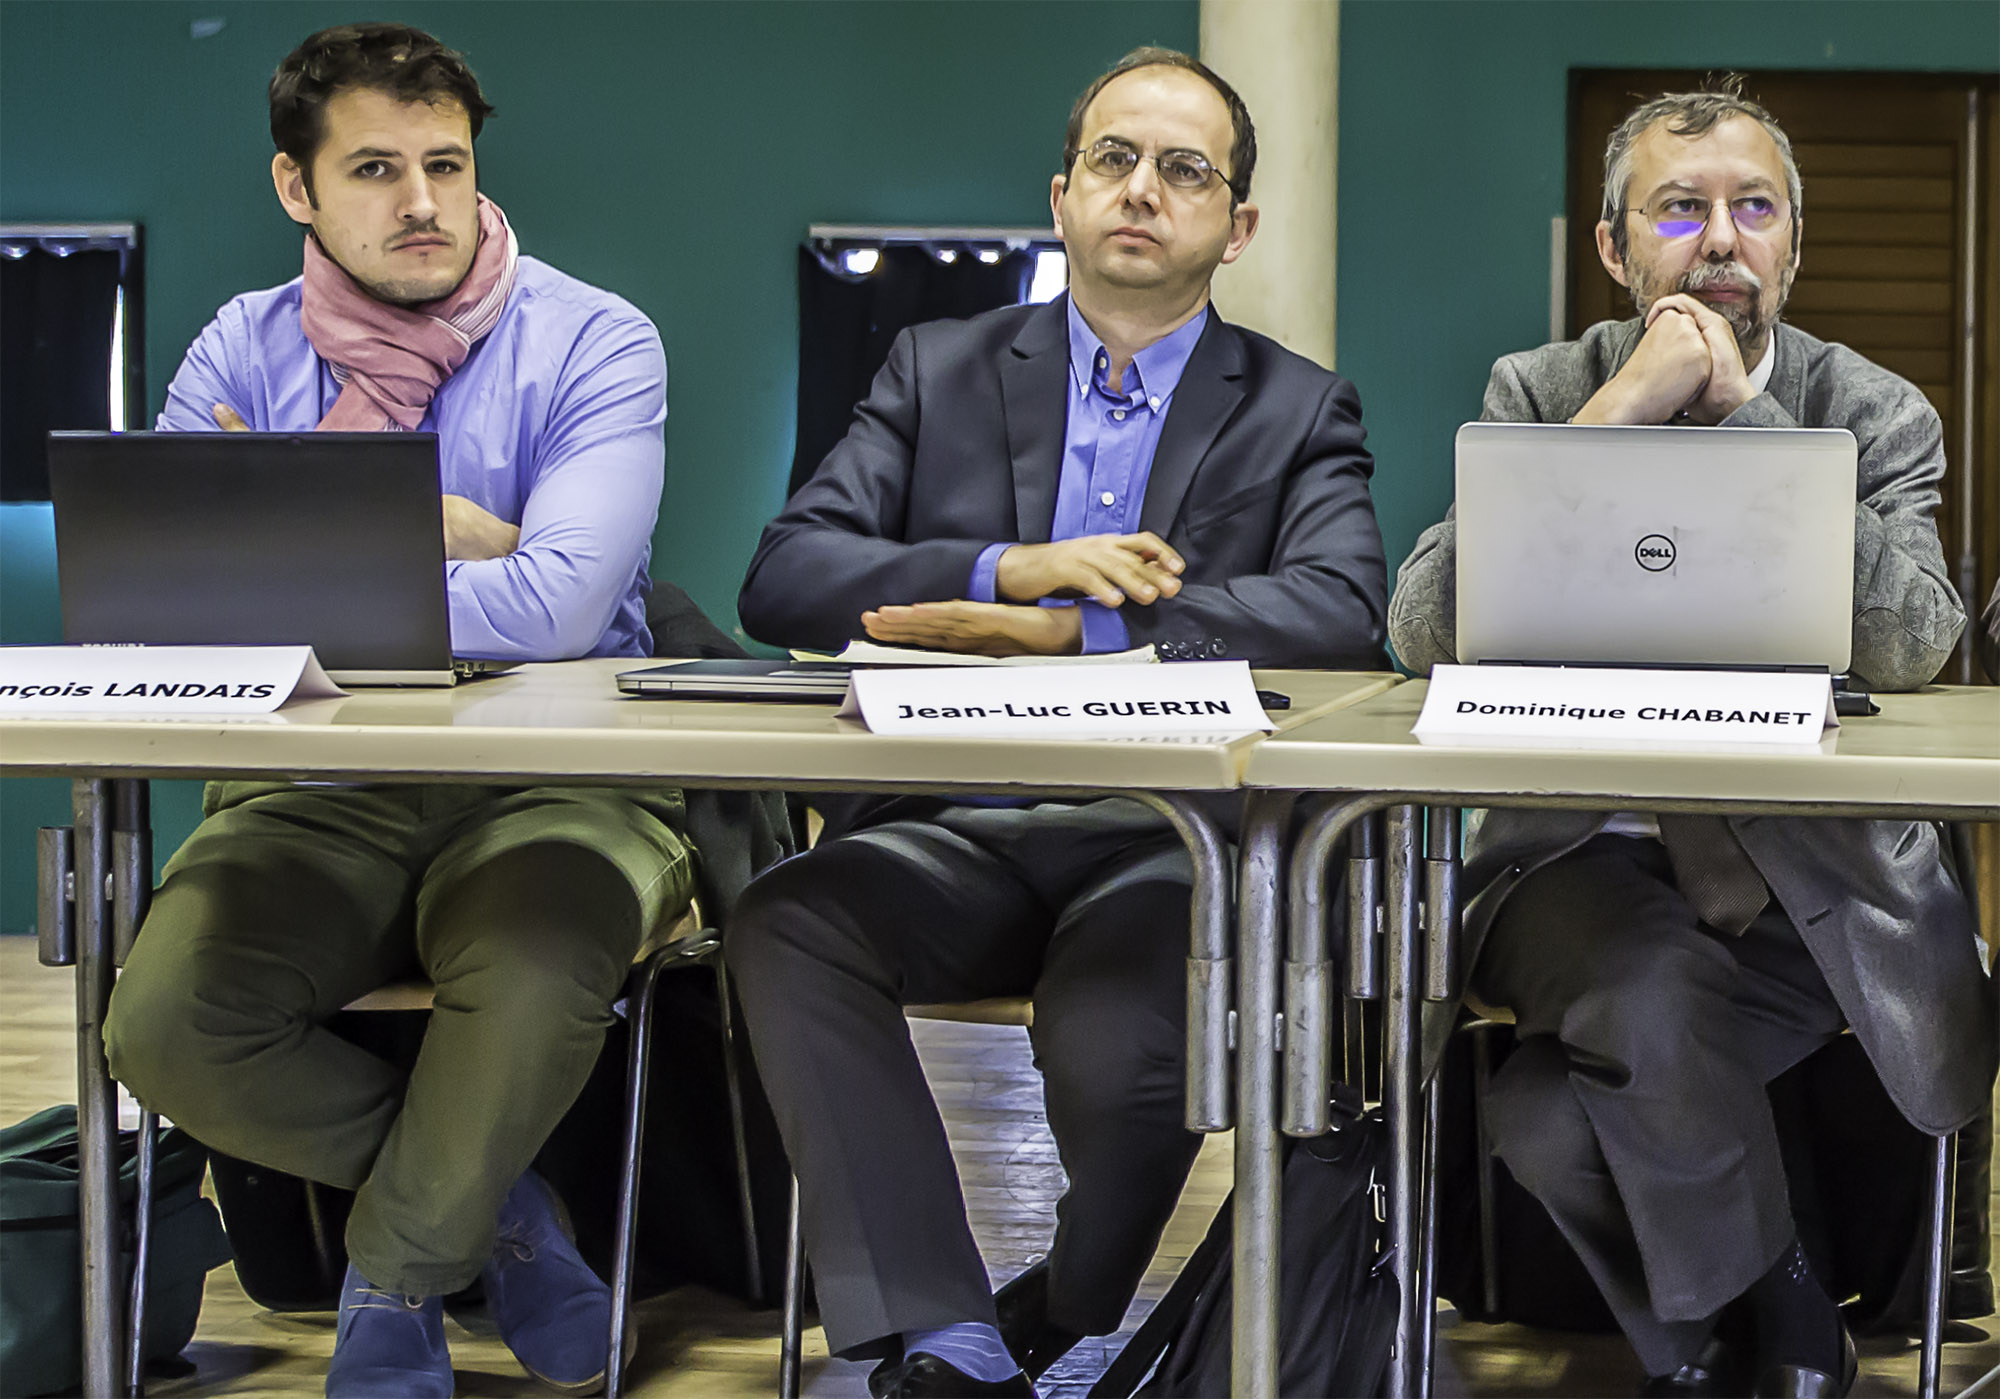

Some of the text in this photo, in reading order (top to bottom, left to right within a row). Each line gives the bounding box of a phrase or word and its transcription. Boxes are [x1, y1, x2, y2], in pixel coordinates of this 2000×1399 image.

[1639, 548, 1672, 558] DELL
[103, 683, 276, 699] LANDAIS
[898, 700, 1232, 719] Jean-Luc GUERIN
[1456, 701, 1812, 725] Dominique CHABANET
